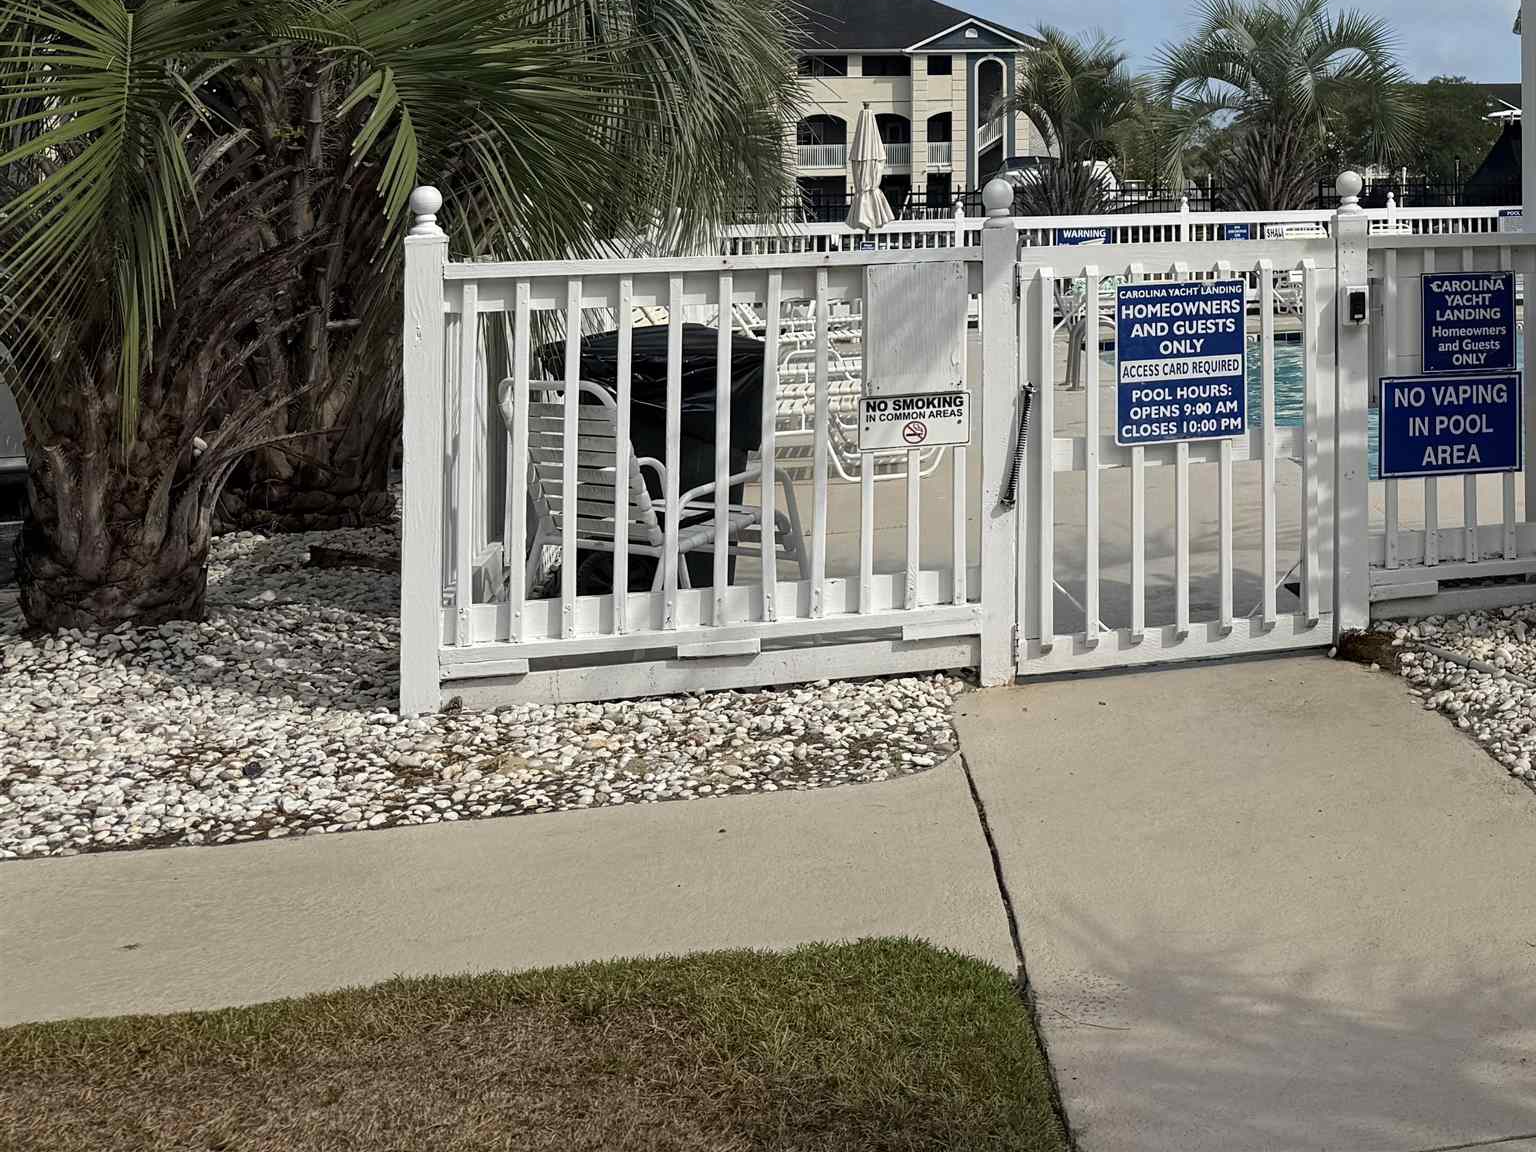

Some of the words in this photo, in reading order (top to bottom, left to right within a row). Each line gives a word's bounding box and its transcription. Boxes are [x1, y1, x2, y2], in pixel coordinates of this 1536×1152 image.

[1063, 229, 1106, 238] WARNING
[1119, 289, 1167, 299] CAROLINA
[1168, 287, 1198, 297] YACHT
[1201, 284, 1242, 295] LANDING
[1432, 279, 1504, 293] CAROLINA
[1444, 293, 1492, 306] YACHT
[1121, 299, 1241, 320] HOMEOWNERS
[1436, 307, 1501, 321] LANDING
[1130, 323, 1169, 338] AND
[1173, 318, 1236, 336] GUESTS
[1432, 325, 1507, 338] Homeowners
[1159, 338, 1205, 355] ONLY
[1438, 340, 1460, 352] and
[1462, 338, 1500, 352] Guests
[1452, 353, 1487, 366] ONLY
[1122, 364, 1160, 379] ACCESS
[1162, 362, 1189, 376] CARD
[1192, 359, 1240, 375] REQUIRED
[1132, 387, 1173, 402] POOL
[1176, 383, 1233, 399] HOURS:
[1394, 386, 1426, 408] NO
[1431, 383, 1508, 406] VAPING
[865, 400, 888, 413] NO
[892, 396, 964, 411] SMOKING
[1129, 404, 1180, 420] OPENS
[1183, 402, 1212, 416] 9:00
[1215, 400, 1238, 414] AM
[865, 413, 876, 423] IN
[879, 410, 926, 422] COMMON
[928, 408, 963, 419] AREAS
[1121, 421, 1177, 438] CLOSES
[1183, 419, 1217, 434] 10:00
[1220, 417, 1242, 431] PM
[1408, 416, 1429, 437] IN
[1435, 413, 1494, 436] POOL
[1421, 444, 1481, 466] AREA
